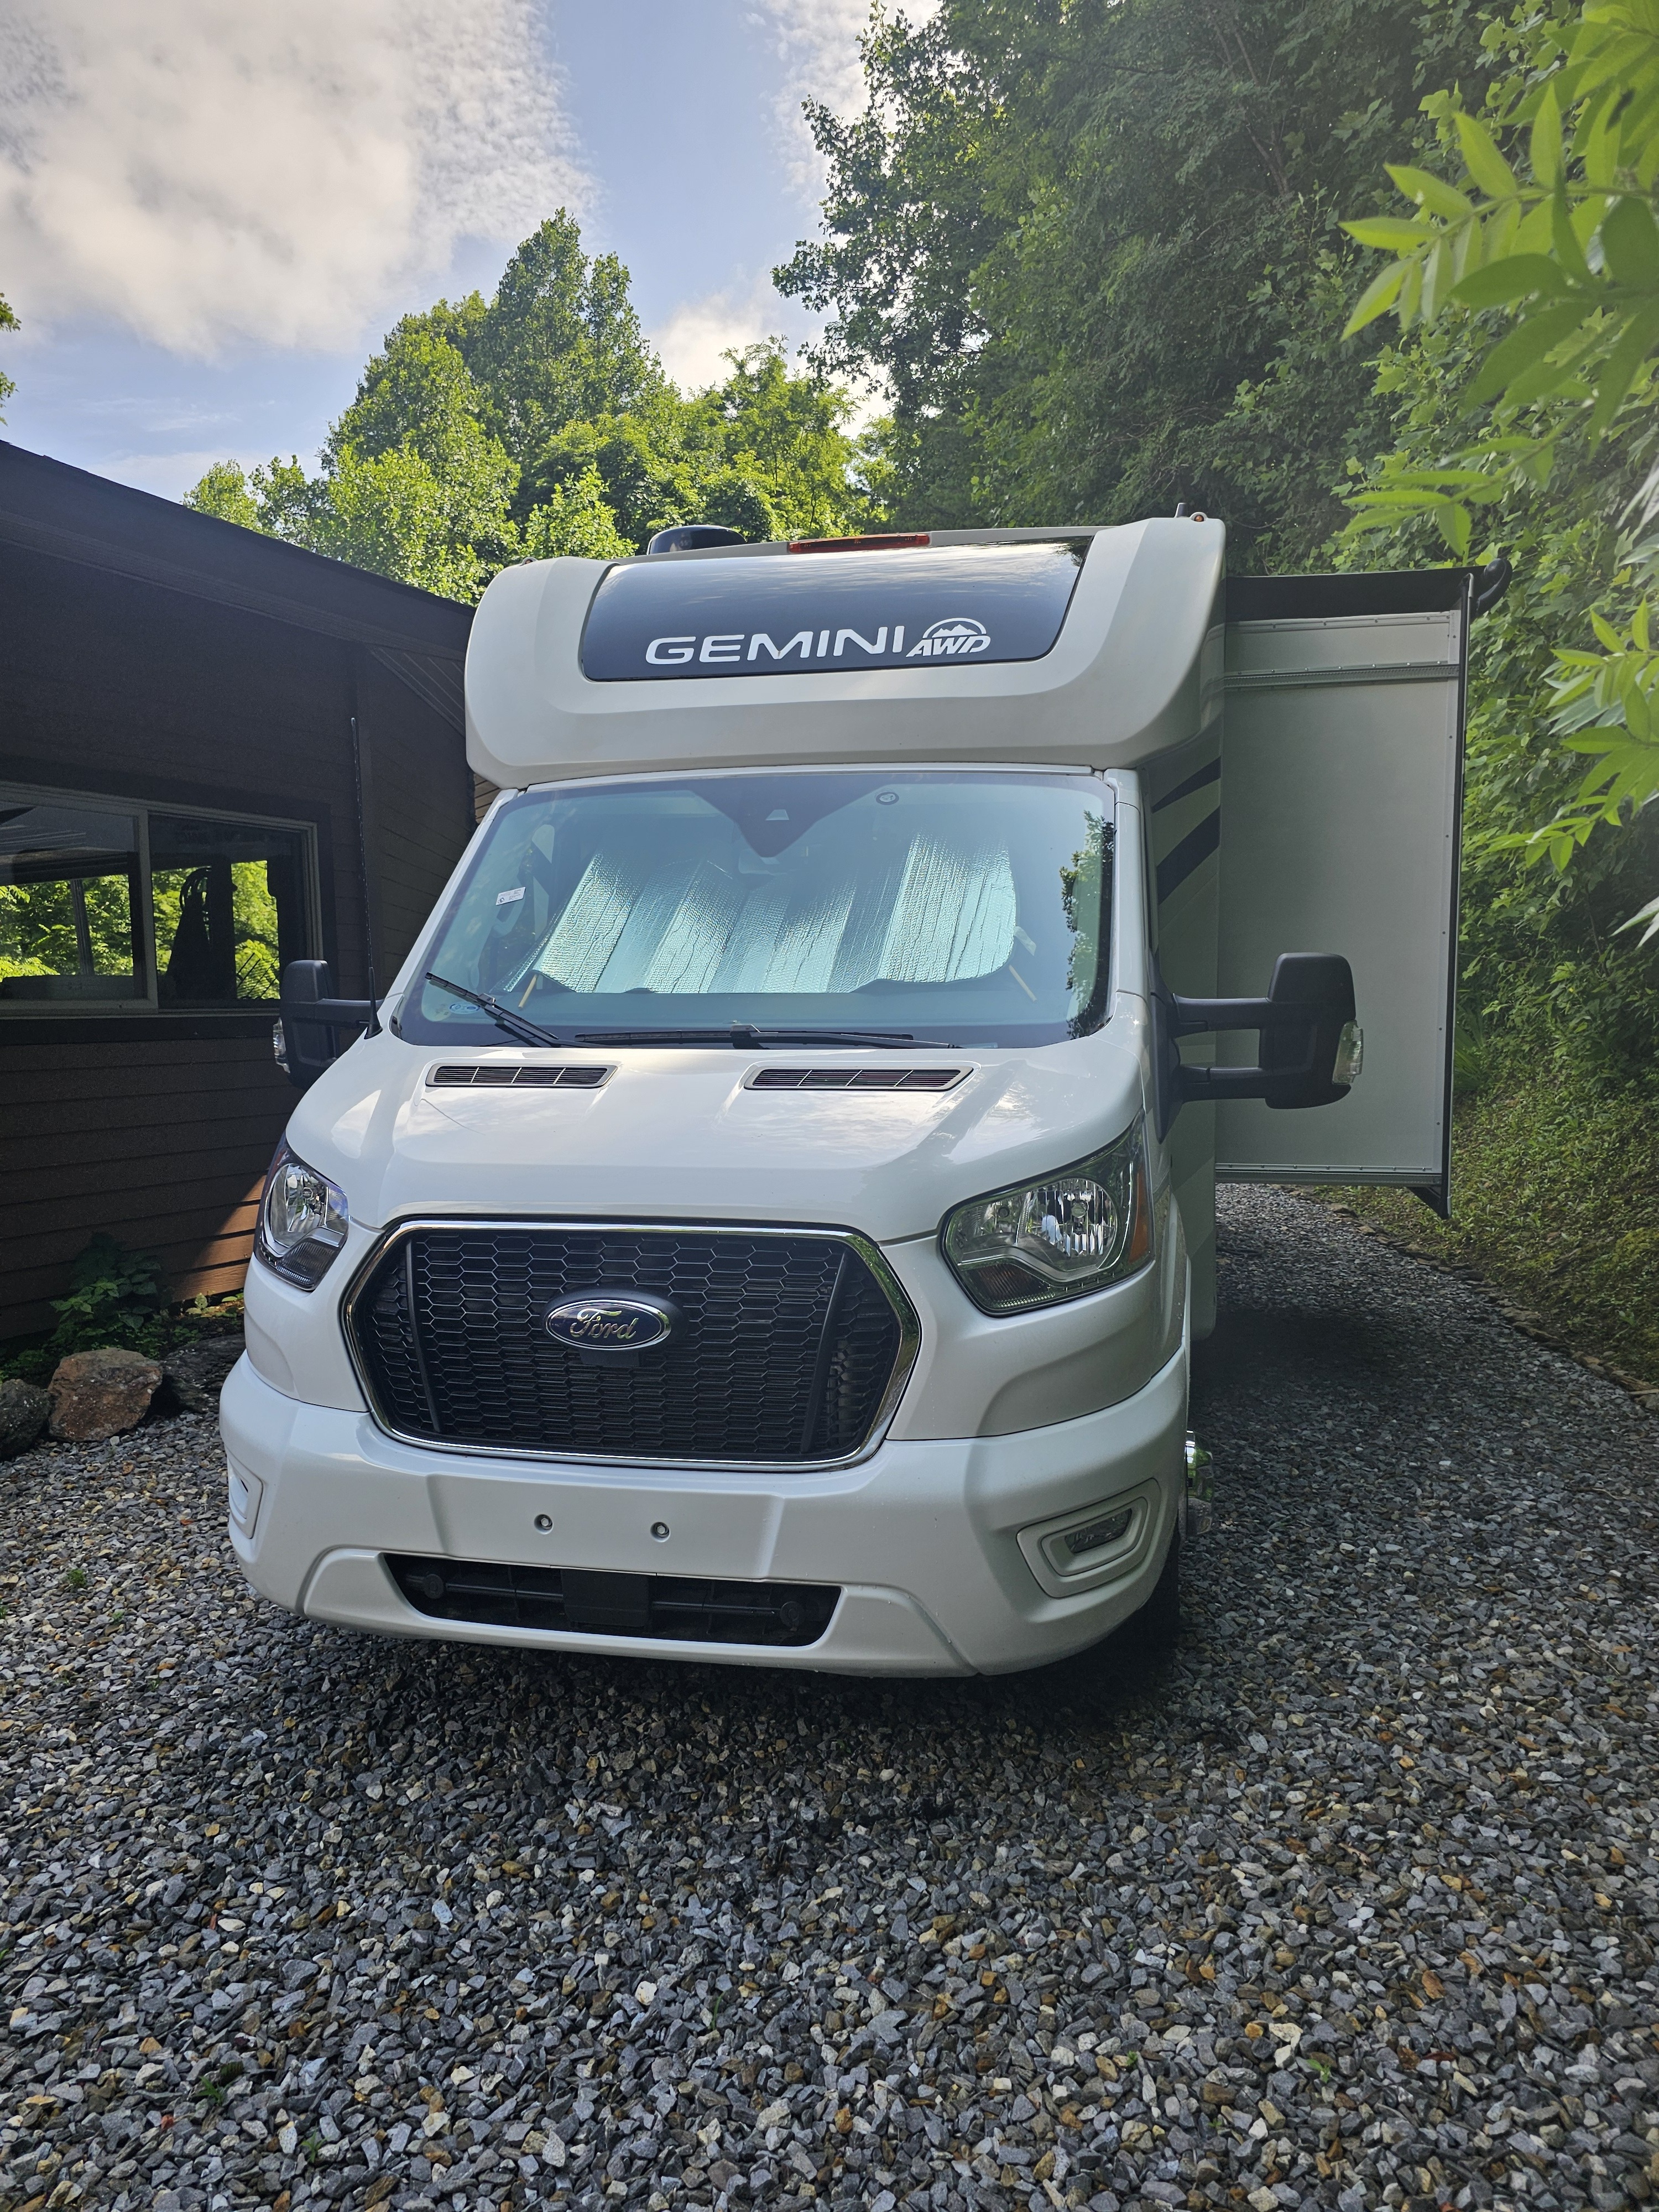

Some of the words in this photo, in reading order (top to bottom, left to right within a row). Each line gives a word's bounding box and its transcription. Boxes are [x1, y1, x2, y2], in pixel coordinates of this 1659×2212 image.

[645, 625, 905, 665] GEMINI
[906, 635, 991, 658] AWD
[570, 1308, 639, 1339] Ford
